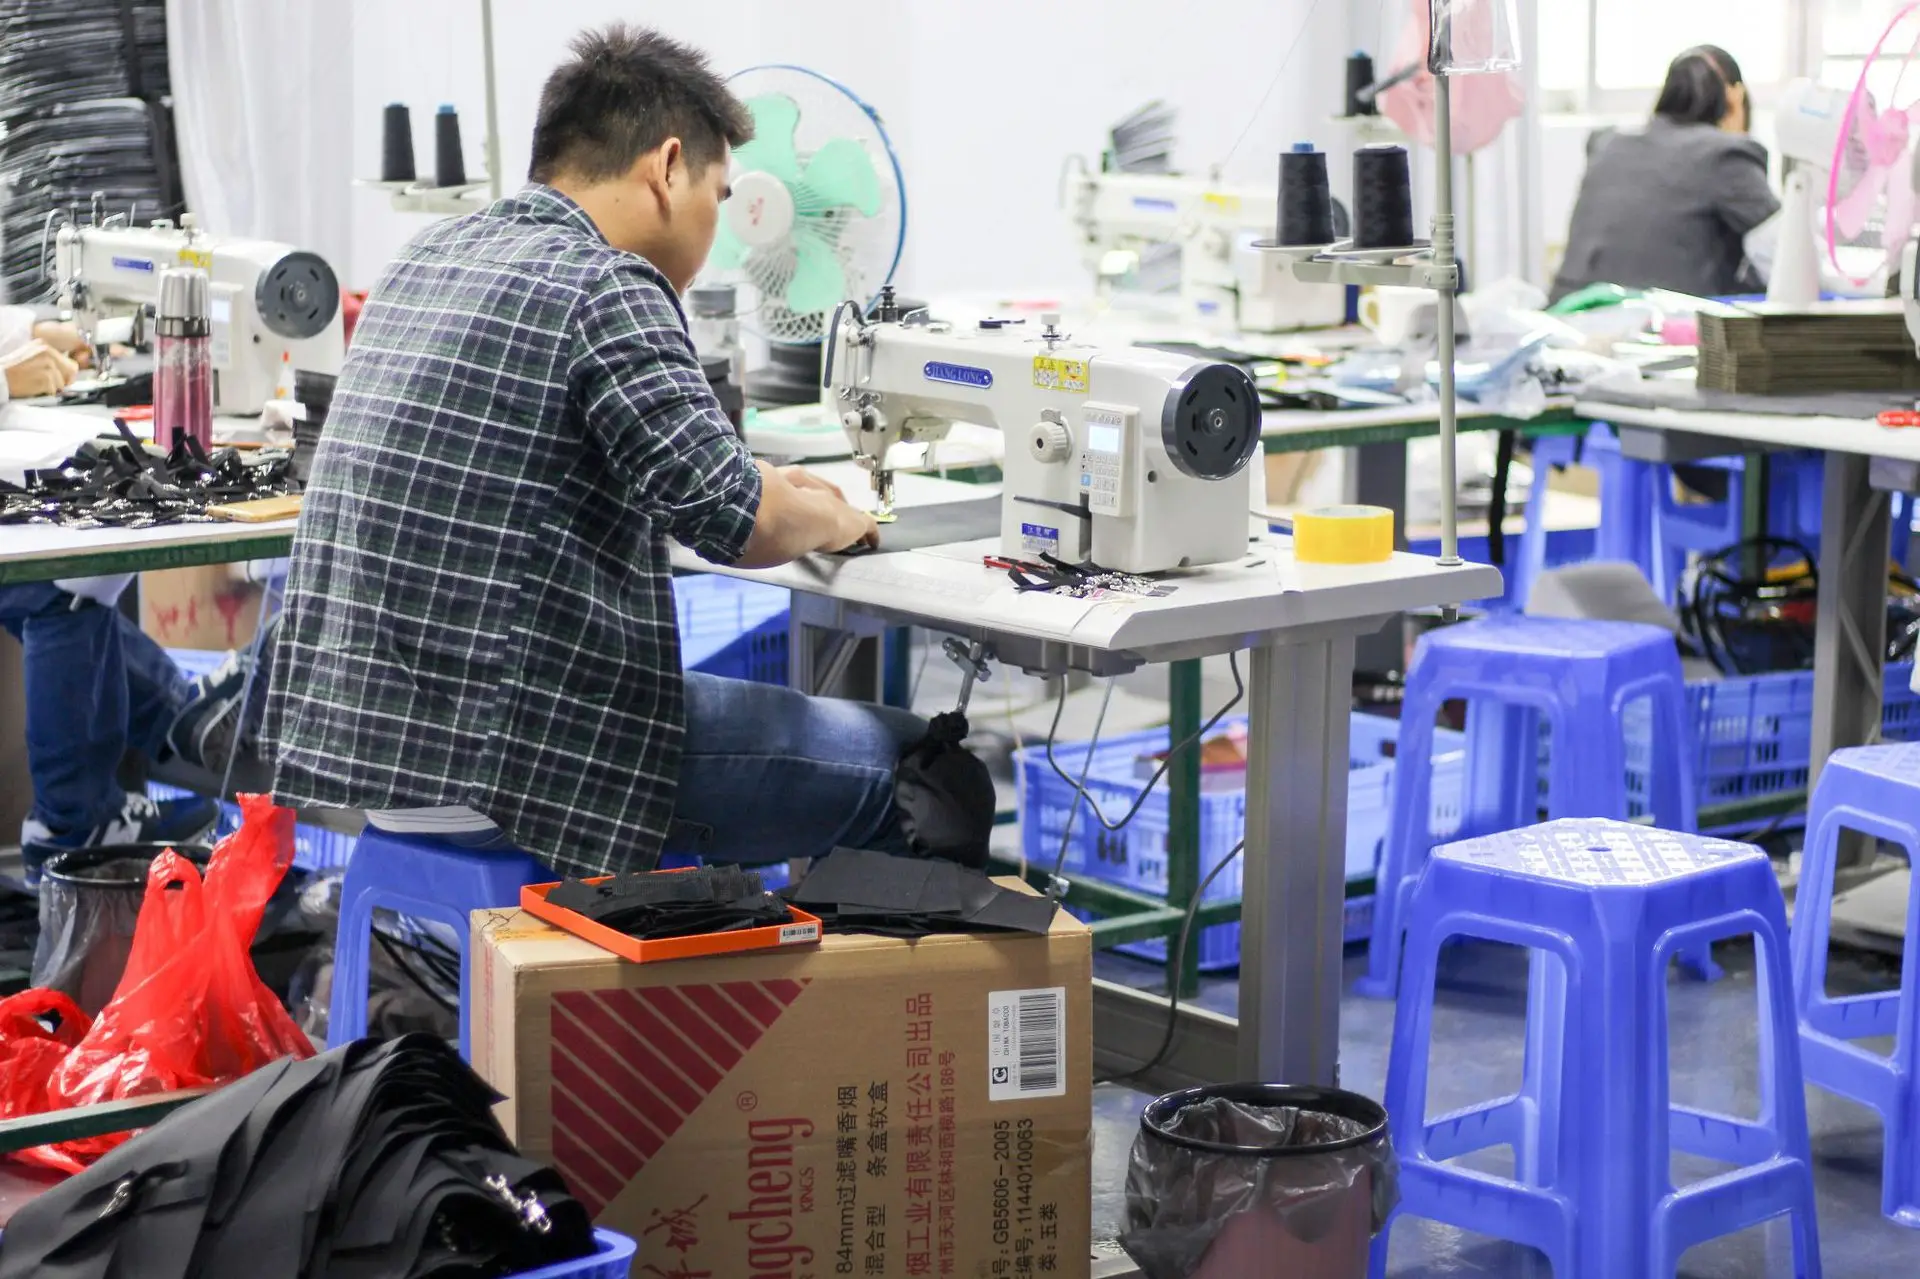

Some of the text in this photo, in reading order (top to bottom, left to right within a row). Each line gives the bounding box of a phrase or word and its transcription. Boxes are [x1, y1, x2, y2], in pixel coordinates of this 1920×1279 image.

[728, 1117, 814, 1279] gcheng
[799, 1166, 813, 1213] KINGS
[836, 1085, 858, 1275] 84mm过滤嘴香烟
[865, 1081, 889, 1276] 混合型 条盒软盒
[906, 993, 933, 1277] 烟工业有限责任公司出品
[938, 1050, 955, 1279] 州市天河区林和西横路186号
[1016, 1118, 1034, 1279] 编号:1144010063
